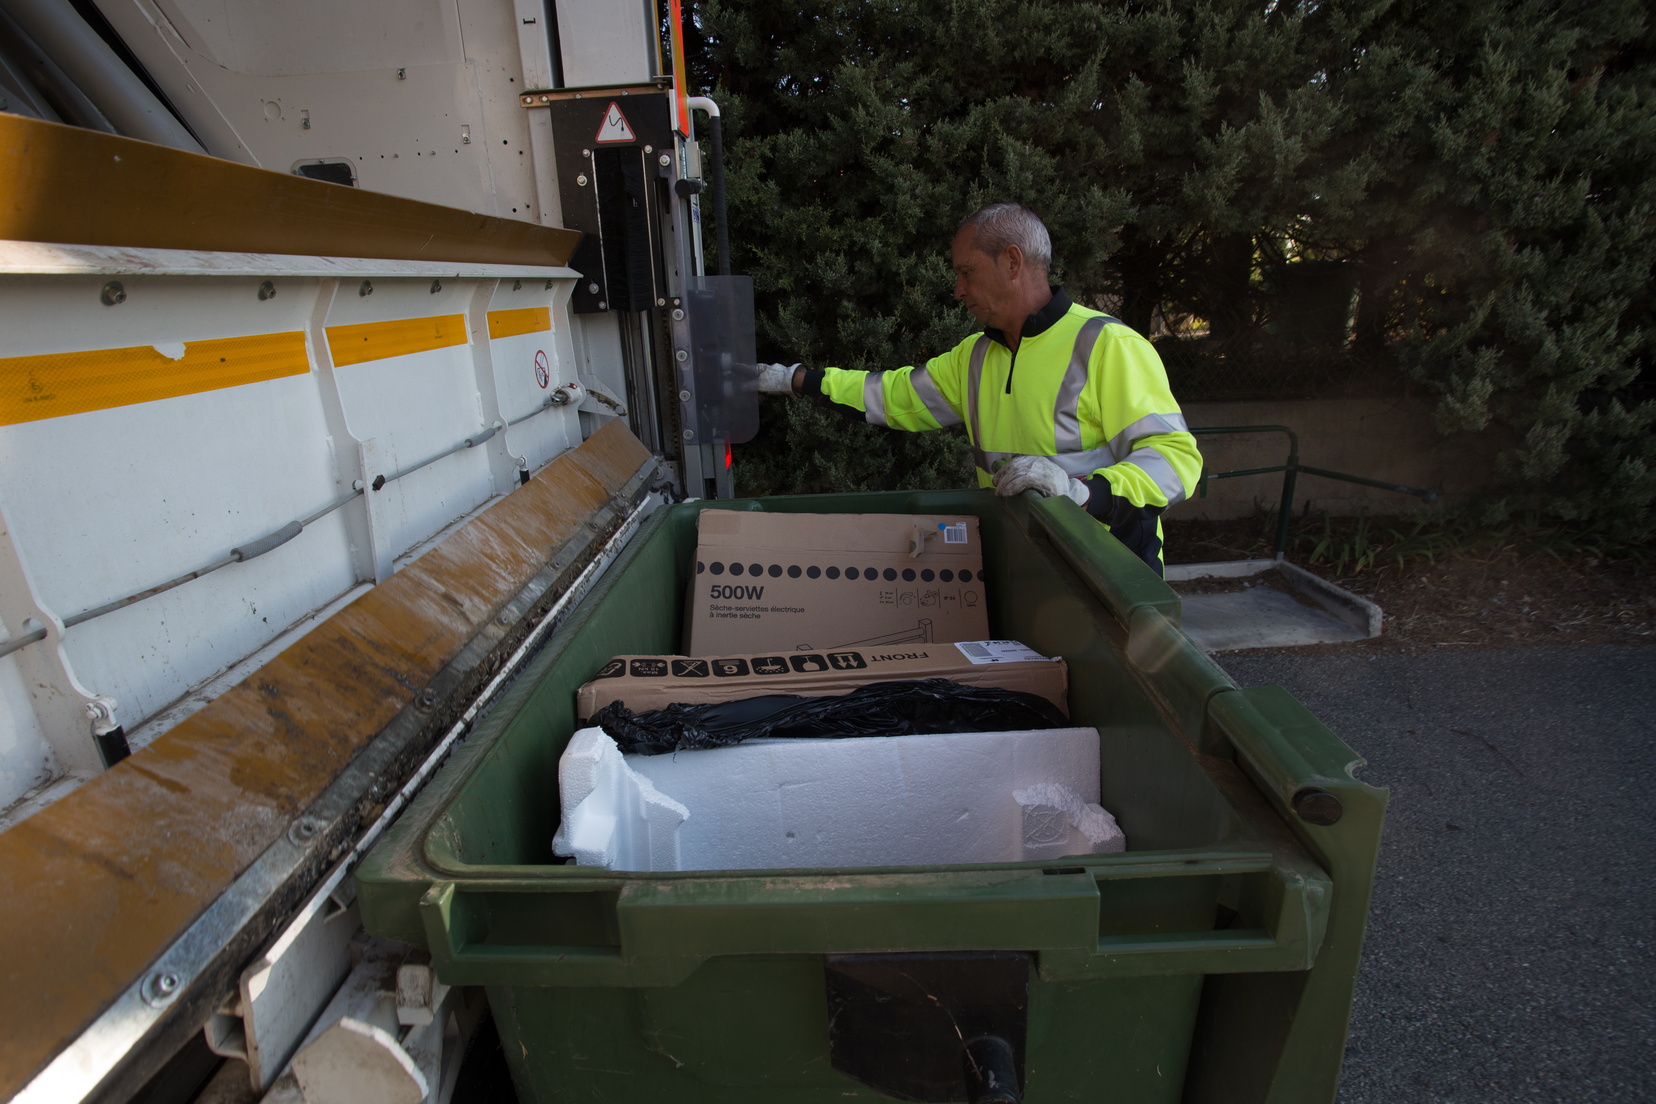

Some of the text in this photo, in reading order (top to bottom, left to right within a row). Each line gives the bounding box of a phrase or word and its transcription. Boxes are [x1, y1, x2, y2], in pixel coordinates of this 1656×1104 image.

[710, 585, 765, 600] 500W
[709, 604, 805, 614] Sèche-serviettes électrique
[870, 651, 929, 663] FRONT
[723, 665, 738, 674] 6
